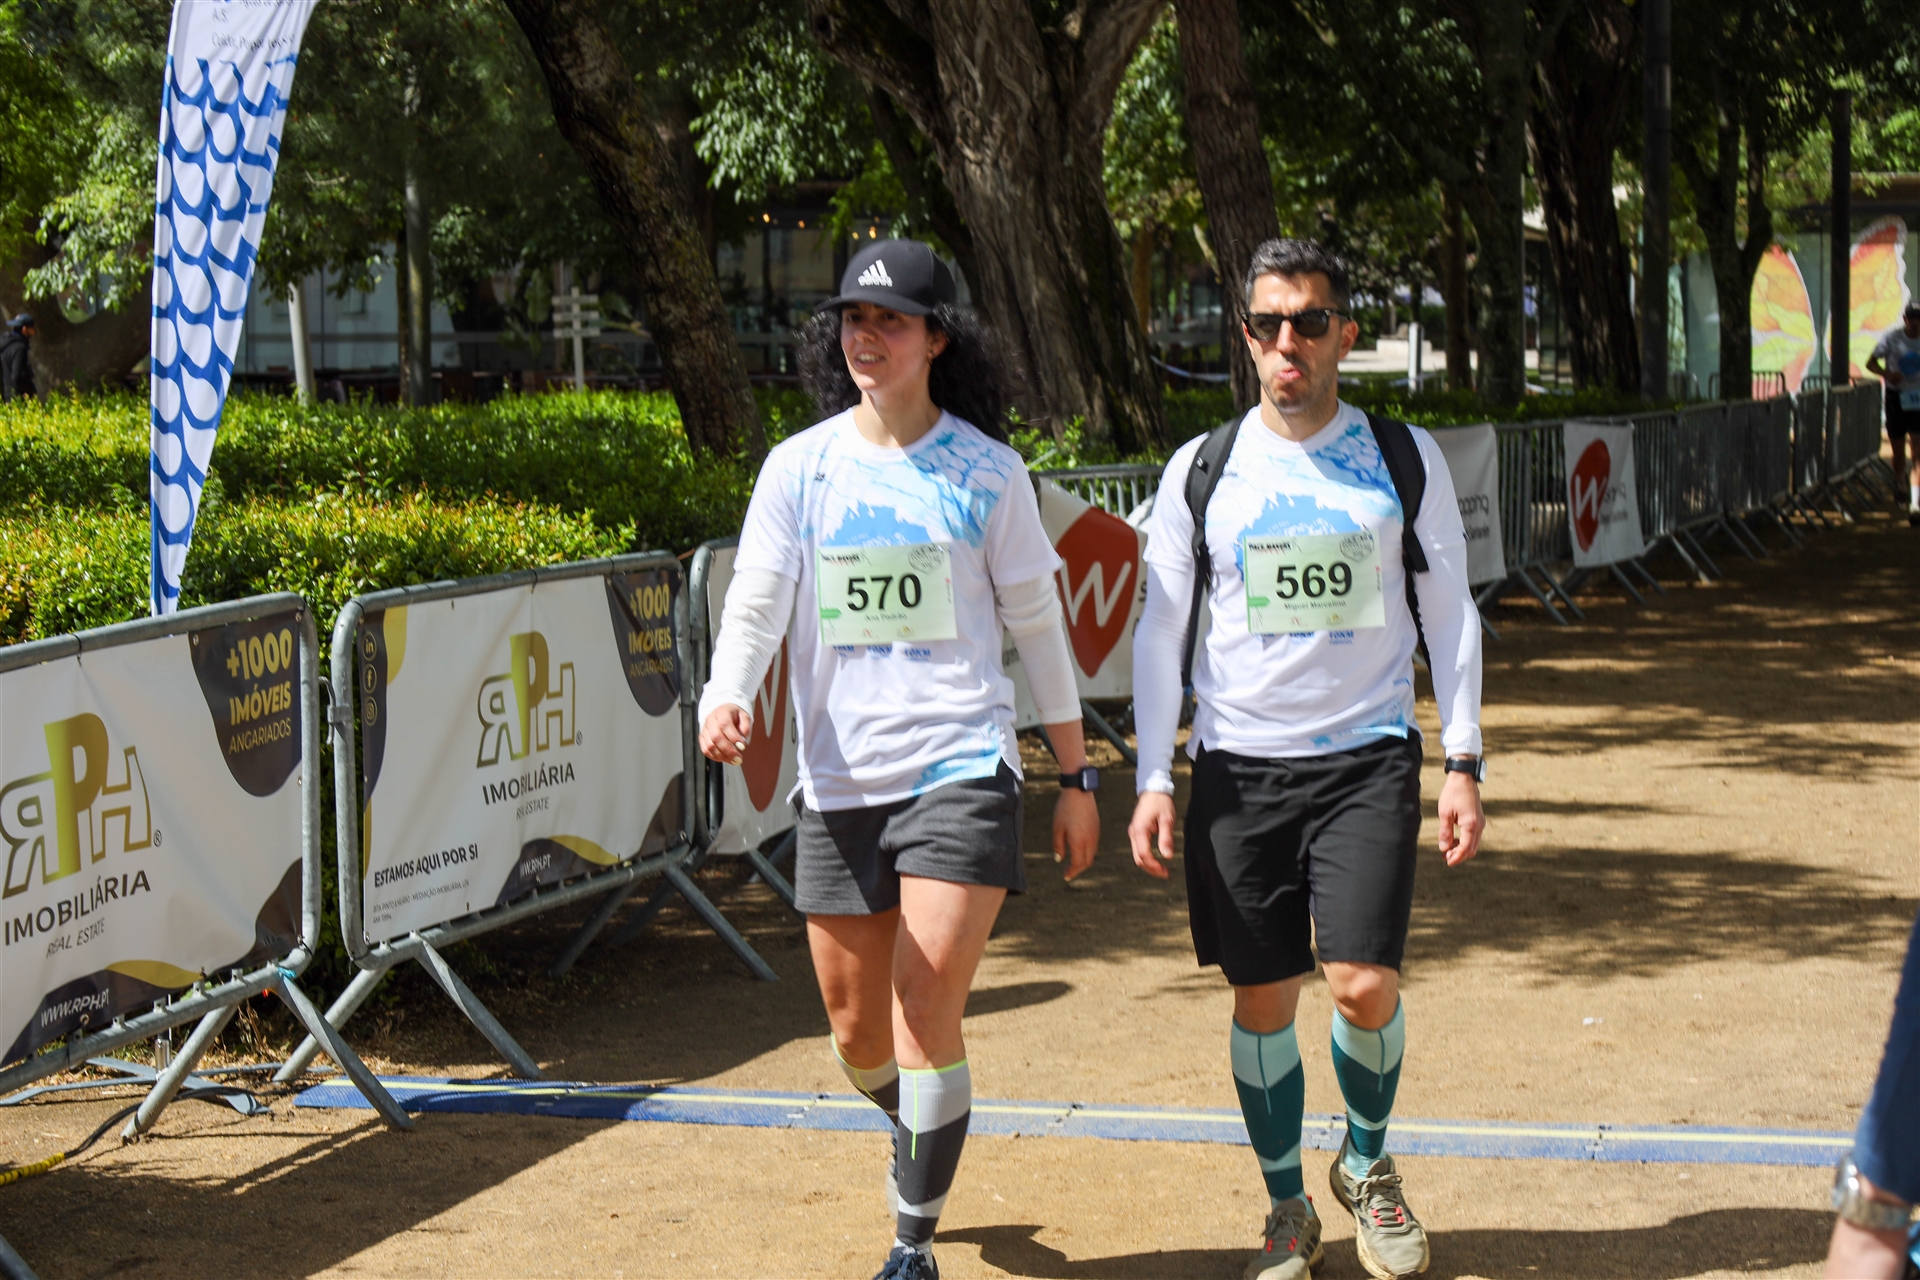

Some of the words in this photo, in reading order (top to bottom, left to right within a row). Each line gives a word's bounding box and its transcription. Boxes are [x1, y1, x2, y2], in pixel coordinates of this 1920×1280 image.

[630, 583, 670, 620] +1000
[847, 572, 922, 612] 570
[1060, 557, 1132, 628] W
[1275, 561, 1353, 600] 569
[1284, 602, 1309, 611] Miguel
[227, 627, 293, 680] +1000
[229, 679, 292, 726] IMÓVEIS
[229, 717, 292, 755] ANGARIADOS
[482, 761, 576, 805] IMOBILIÁRIA
[374, 859, 415, 888] ESTAMOS
[416, 855, 441, 875] AQUI
[444, 846, 467, 868] POR
[469, 843, 479, 860] SI
[4, 869, 151, 946] IMOBILIÁRIA
[46, 933, 72, 959] REAL
[77, 917, 106, 947] ESTATE
[41, 987, 111, 1028] WWW.RPH.PT
